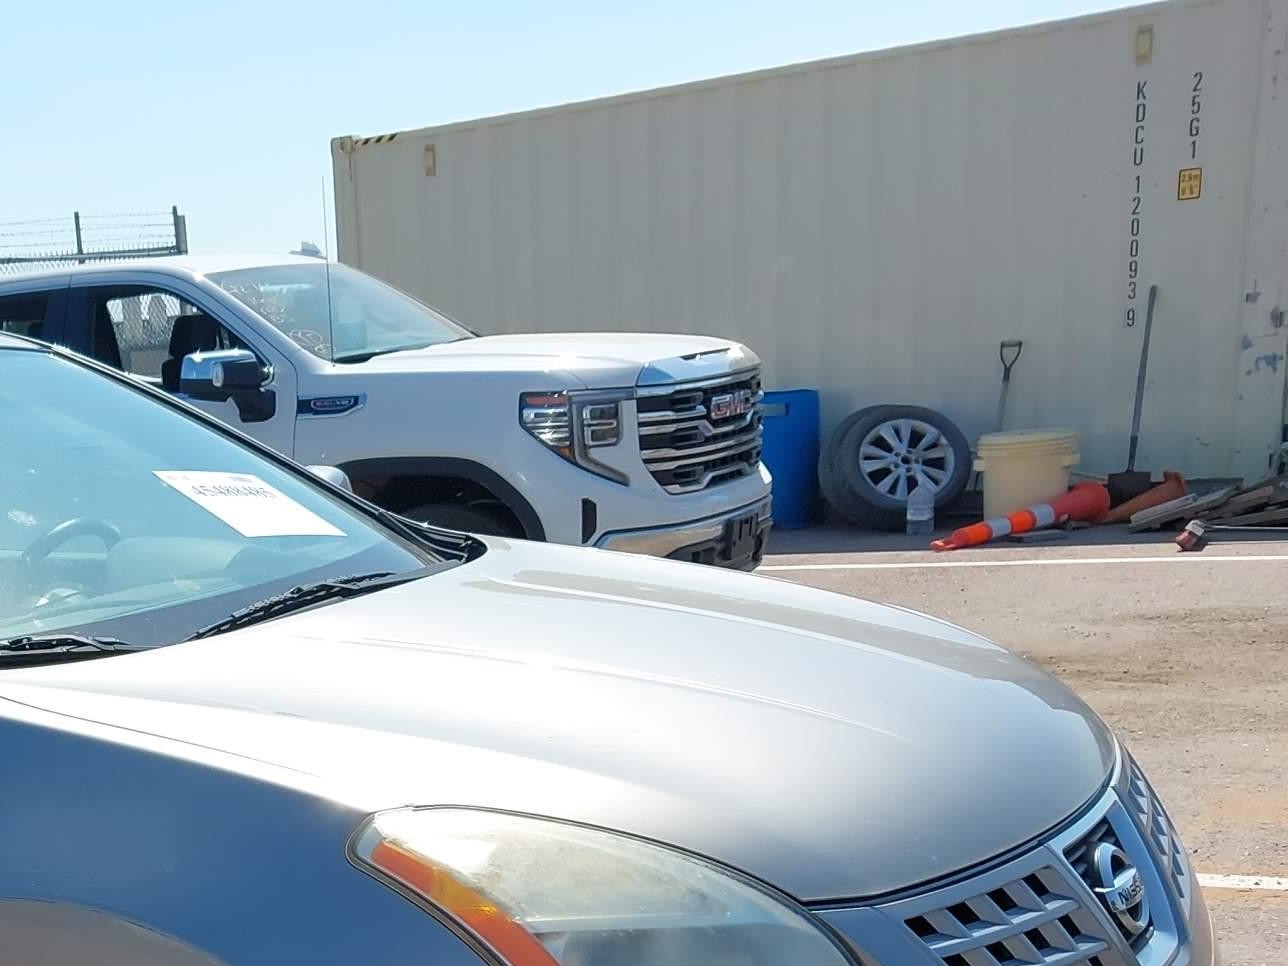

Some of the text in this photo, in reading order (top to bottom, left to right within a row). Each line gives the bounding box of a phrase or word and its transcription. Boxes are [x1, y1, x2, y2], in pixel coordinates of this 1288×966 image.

[1133, 81, 1148, 166] KDCU
[1189, 72, 1203, 159] 25G1
[711, 390, 752, 420] GMC
